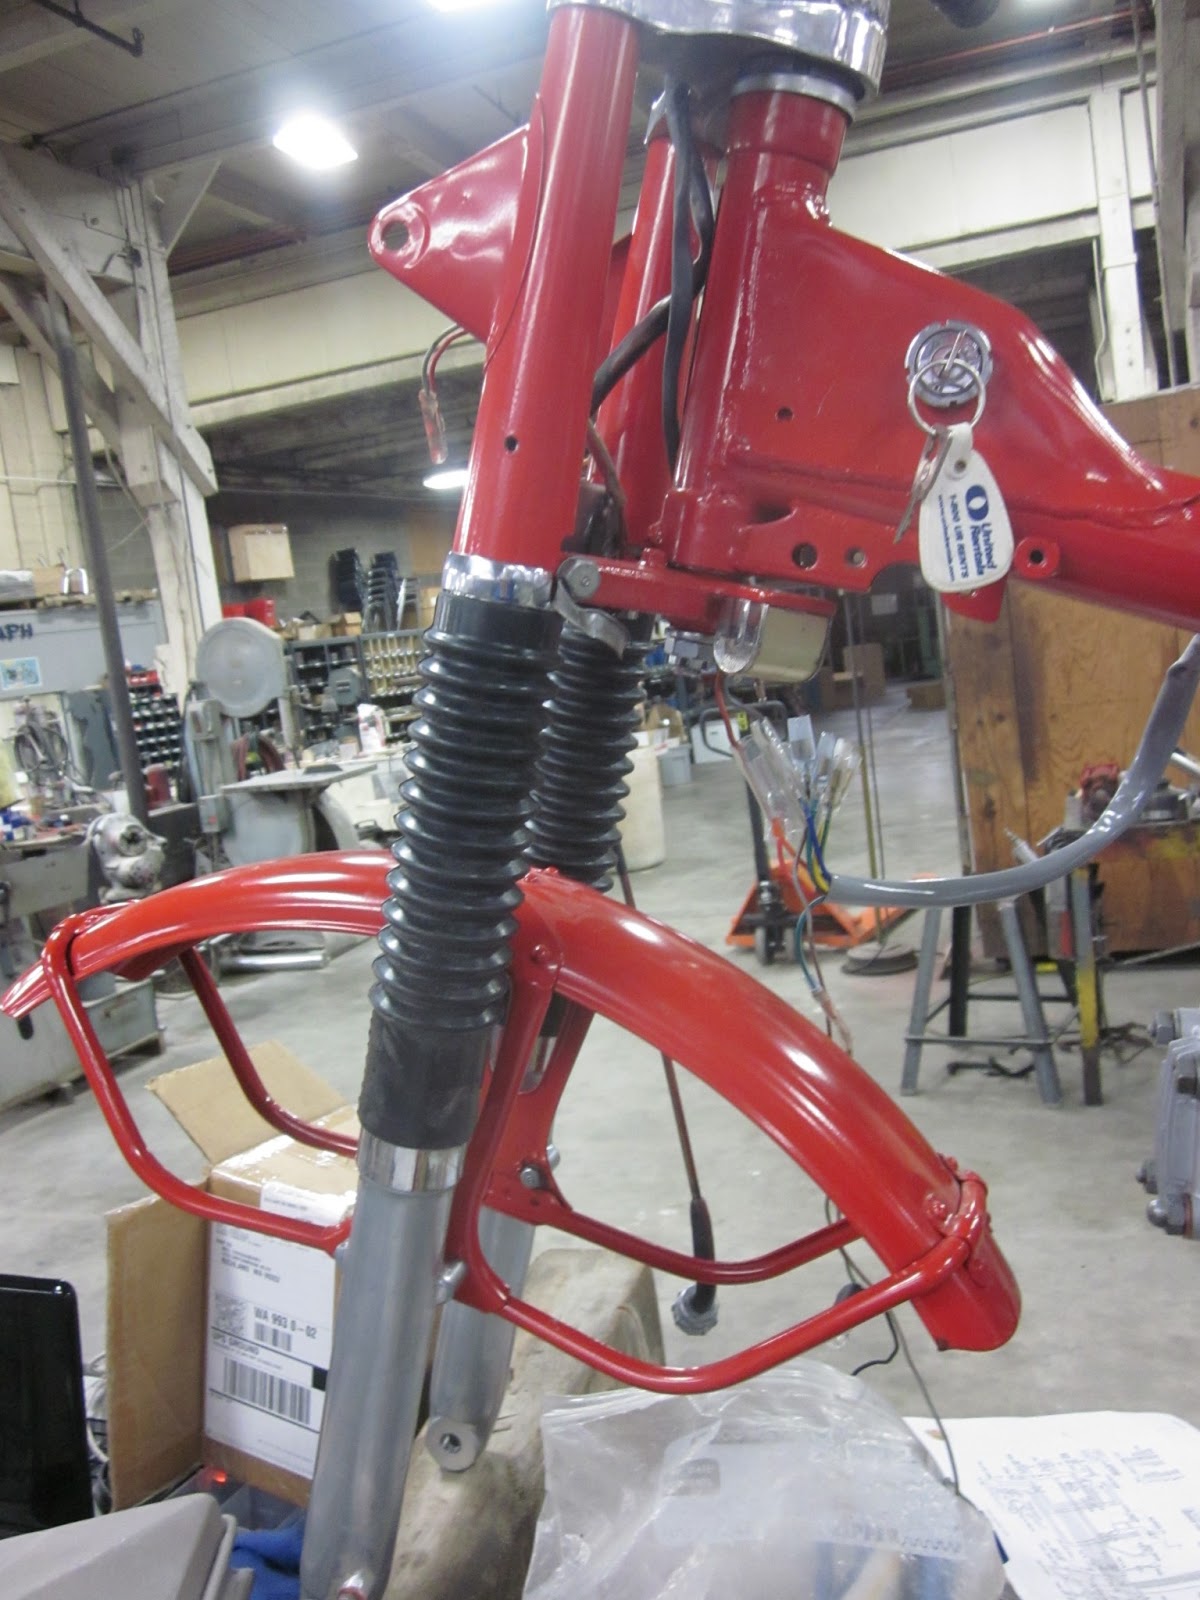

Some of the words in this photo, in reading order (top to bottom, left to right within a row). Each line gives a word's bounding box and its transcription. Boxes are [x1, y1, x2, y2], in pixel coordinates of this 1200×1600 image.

[957, 543, 968, 578] RENTS
[970, 526, 984, 575] Rentals
[981, 523, 997, 569] United
[255, 1307, 269, 1320] WA
